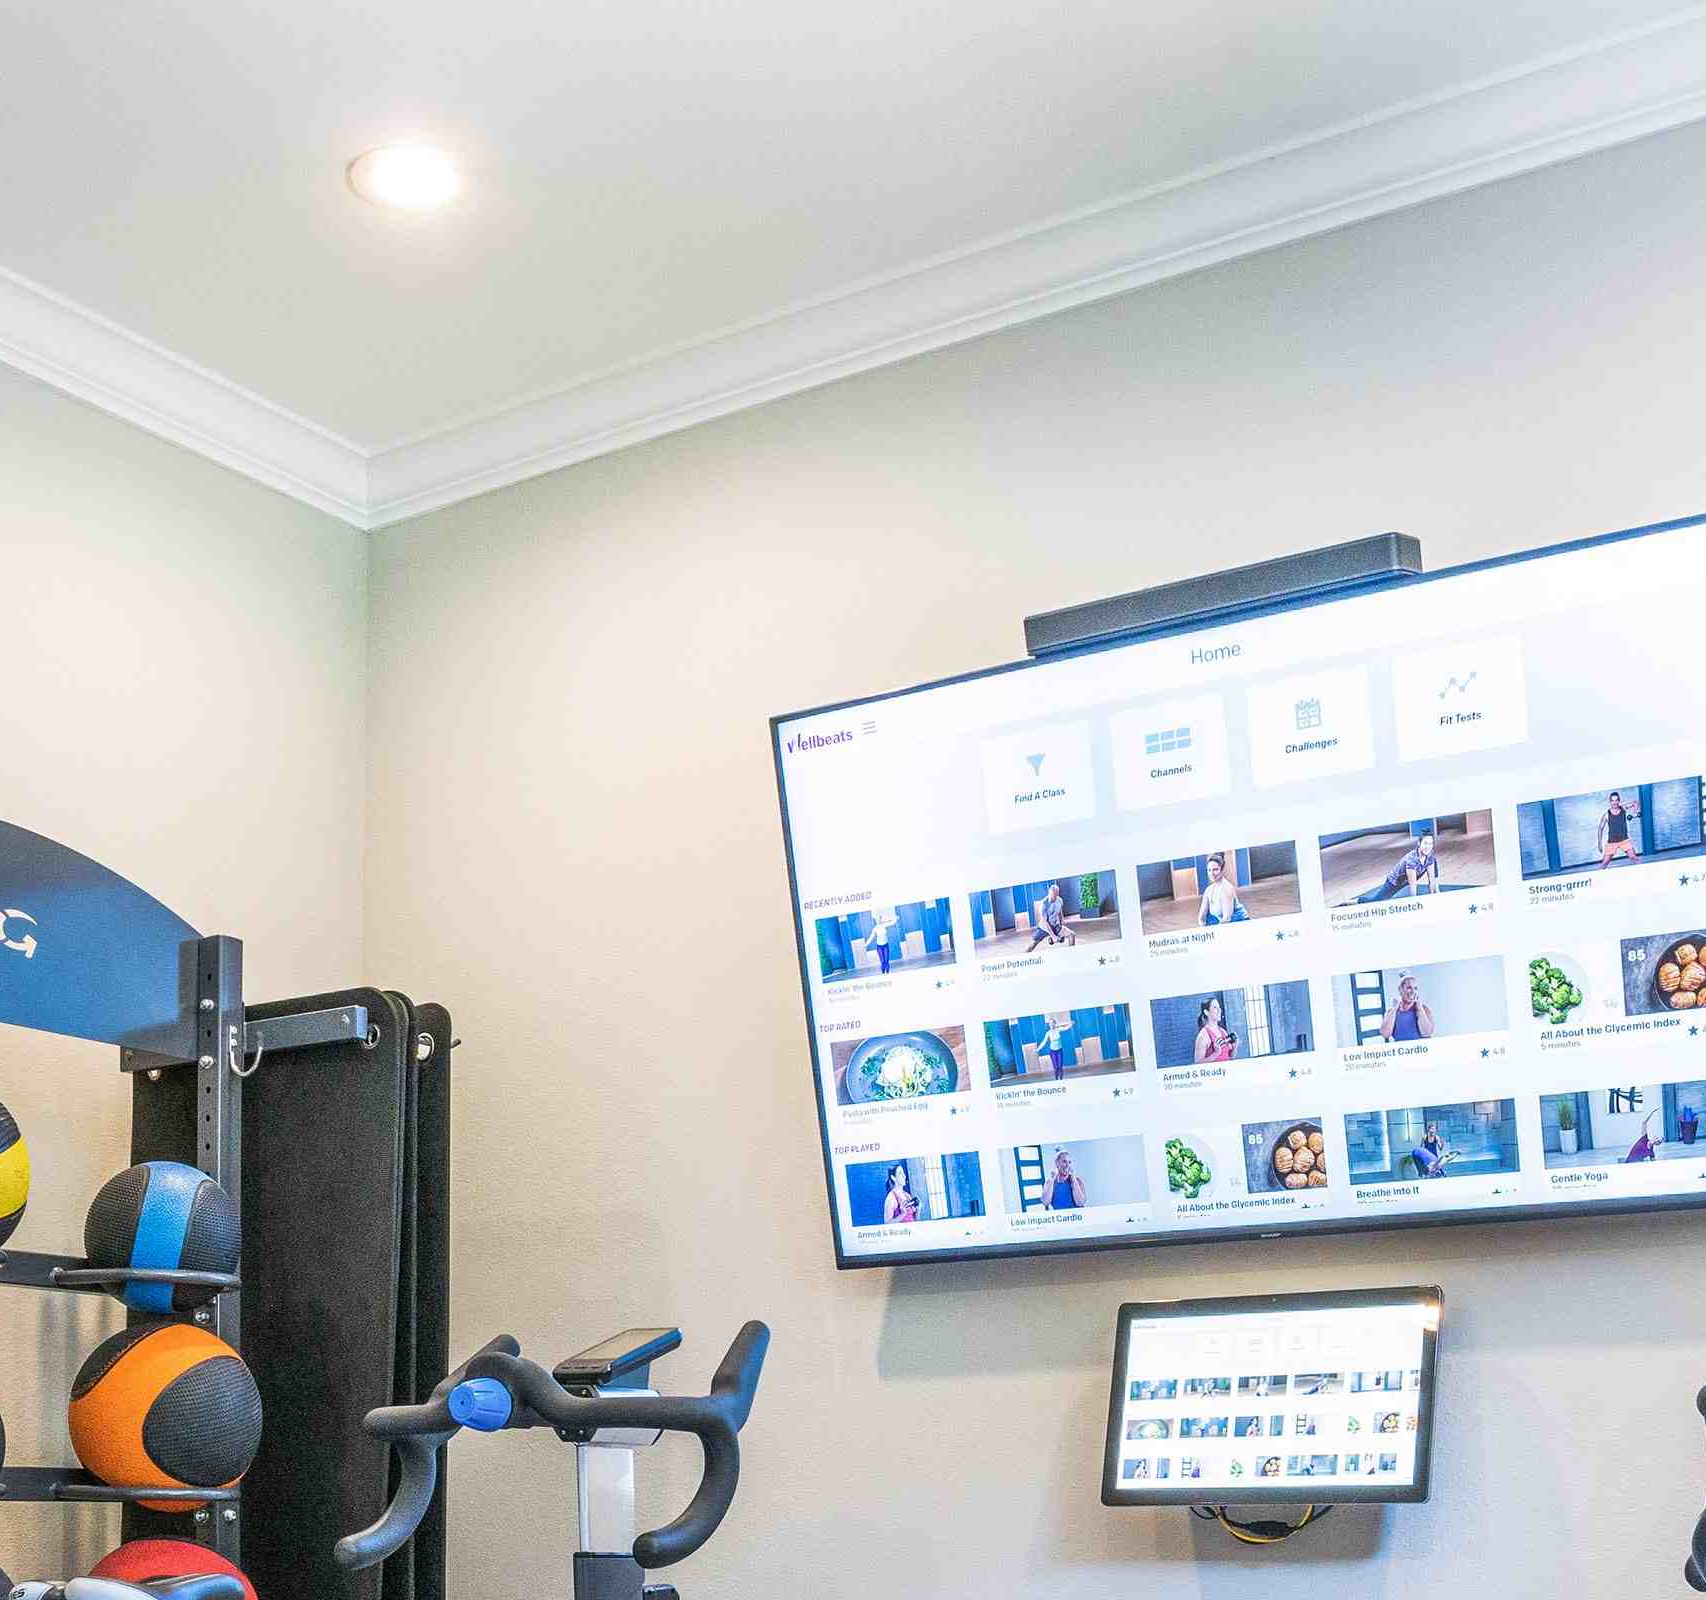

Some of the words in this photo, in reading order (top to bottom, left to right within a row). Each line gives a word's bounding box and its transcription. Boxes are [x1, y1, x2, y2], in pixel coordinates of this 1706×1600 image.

[1190, 641, 1242, 665] Home
[1438, 713, 1453, 727] Fit
[1454, 710, 1482, 725] Tests
[1284, 735, 1339, 754] Challenges
[1149, 762, 1194, 779] Channels
[1013, 791, 1033, 804] Find
[1034, 792, 1041, 801] A
[1042, 786, 1066, 800] Class
[1331, 910, 1369, 923] Focused
[1371, 907, 1387, 918] Hip
[1388, 902, 1423, 914] Stretch
[1192, 931, 1215, 945] Night
[1627, 951, 1646, 963] 85
[1540, 1031, 1554, 1041] All
[1555, 1027, 1584, 1039] About
[1586, 1025, 1603, 1036] the
[1604, 1021, 1651, 1036] Glycemic
[1653, 1017, 1682, 1030] Index
[1343, 1053, 1362, 1062] Low
[1364, 1048, 1396, 1060] Impact
[1397, 1045, 1429, 1056] Cardio
[1163, 1069, 1190, 1081] Armed
[1247, 1133, 1264, 1145] 85
[1550, 1171, 1582, 1184] Gentle
[1584, 1170, 1609, 1183] Yoga
[1355, 1188, 1392, 1199] Breathe
[1176, 1204, 1188, 1213] All
[1189, 1202, 1214, 1212] About
[1215, 1201, 1229, 1210] the
[1230, 1197, 1270, 1211] Glycemic
[1271, 1196, 1296, 1206] Index
